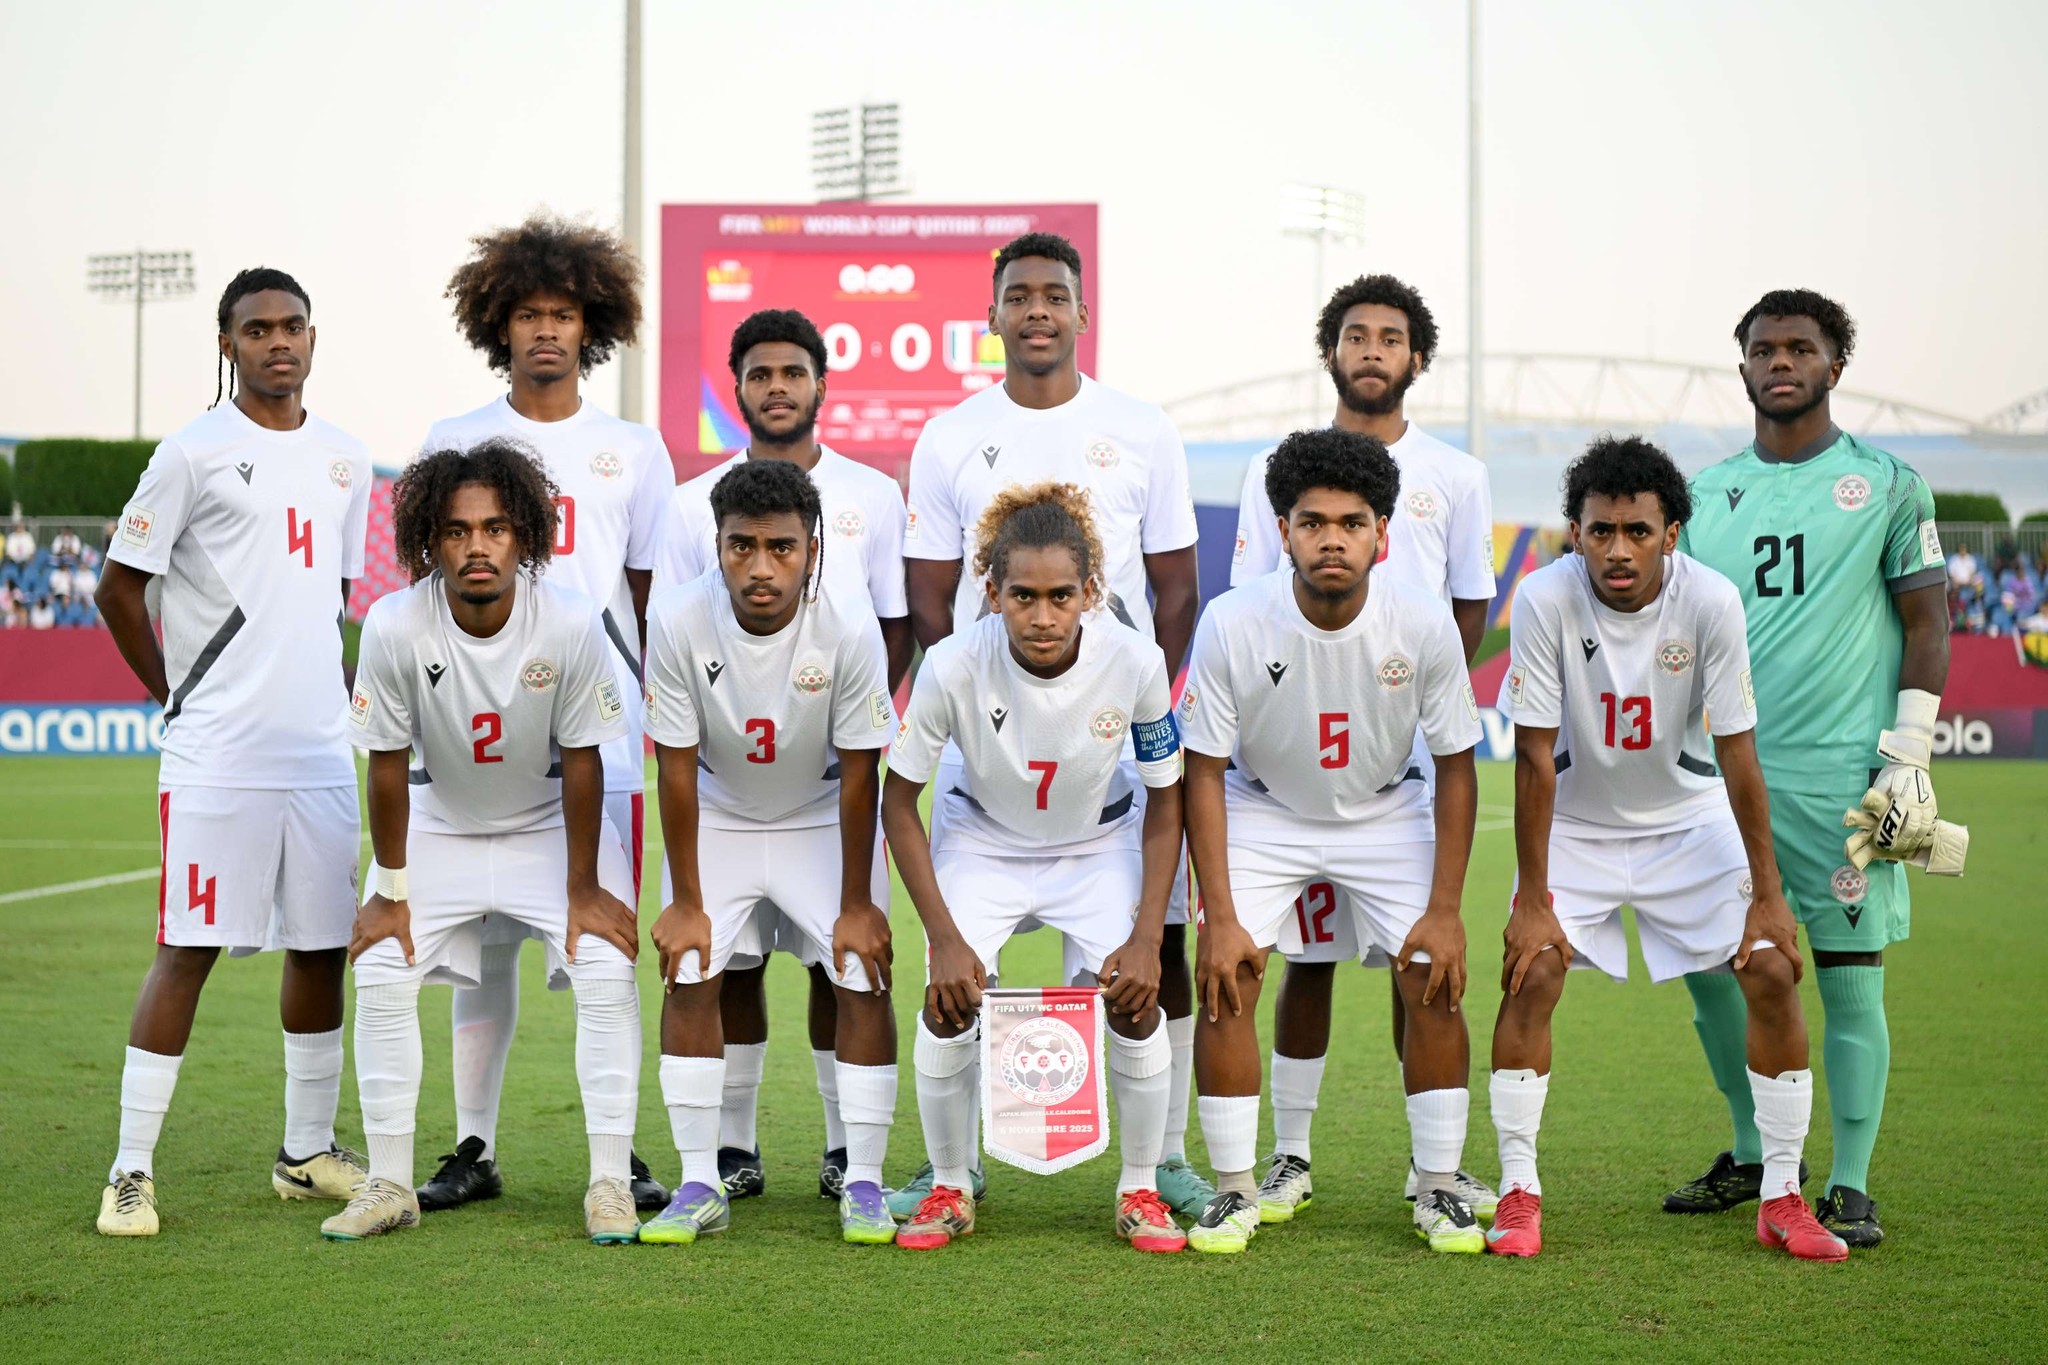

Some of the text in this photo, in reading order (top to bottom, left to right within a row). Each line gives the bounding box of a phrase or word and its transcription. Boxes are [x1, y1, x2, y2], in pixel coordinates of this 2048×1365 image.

[823, 322, 932, 372] 0 0
[287, 507, 313, 568] 4
[1754, 534, 1804, 597] 21
[472, 712, 503, 763] 2
[746, 718, 776, 764] 3
[1137, 717, 1169, 732] FOOTBALL
[1139, 723, 1172, 742] UNITES
[1141, 731, 1175, 751] the World
[1319, 713, 1349, 769] 5
[1600, 692, 1651, 750] 13
[1028, 760, 1058, 810] 7
[188, 864, 216, 925] 4
[1295, 882, 1336, 944] 12
[994, 1005, 1015, 1013] FIFA
[1037, 1004, 1053, 1012] WC
[1055, 1003, 1087, 1012] QATAR
[1033, 1088, 1073, 1103] FOOTBALL
[1009, 1125, 1067, 1134] NOVEMBRE
[1069, 1124, 1093, 1133] 2025
